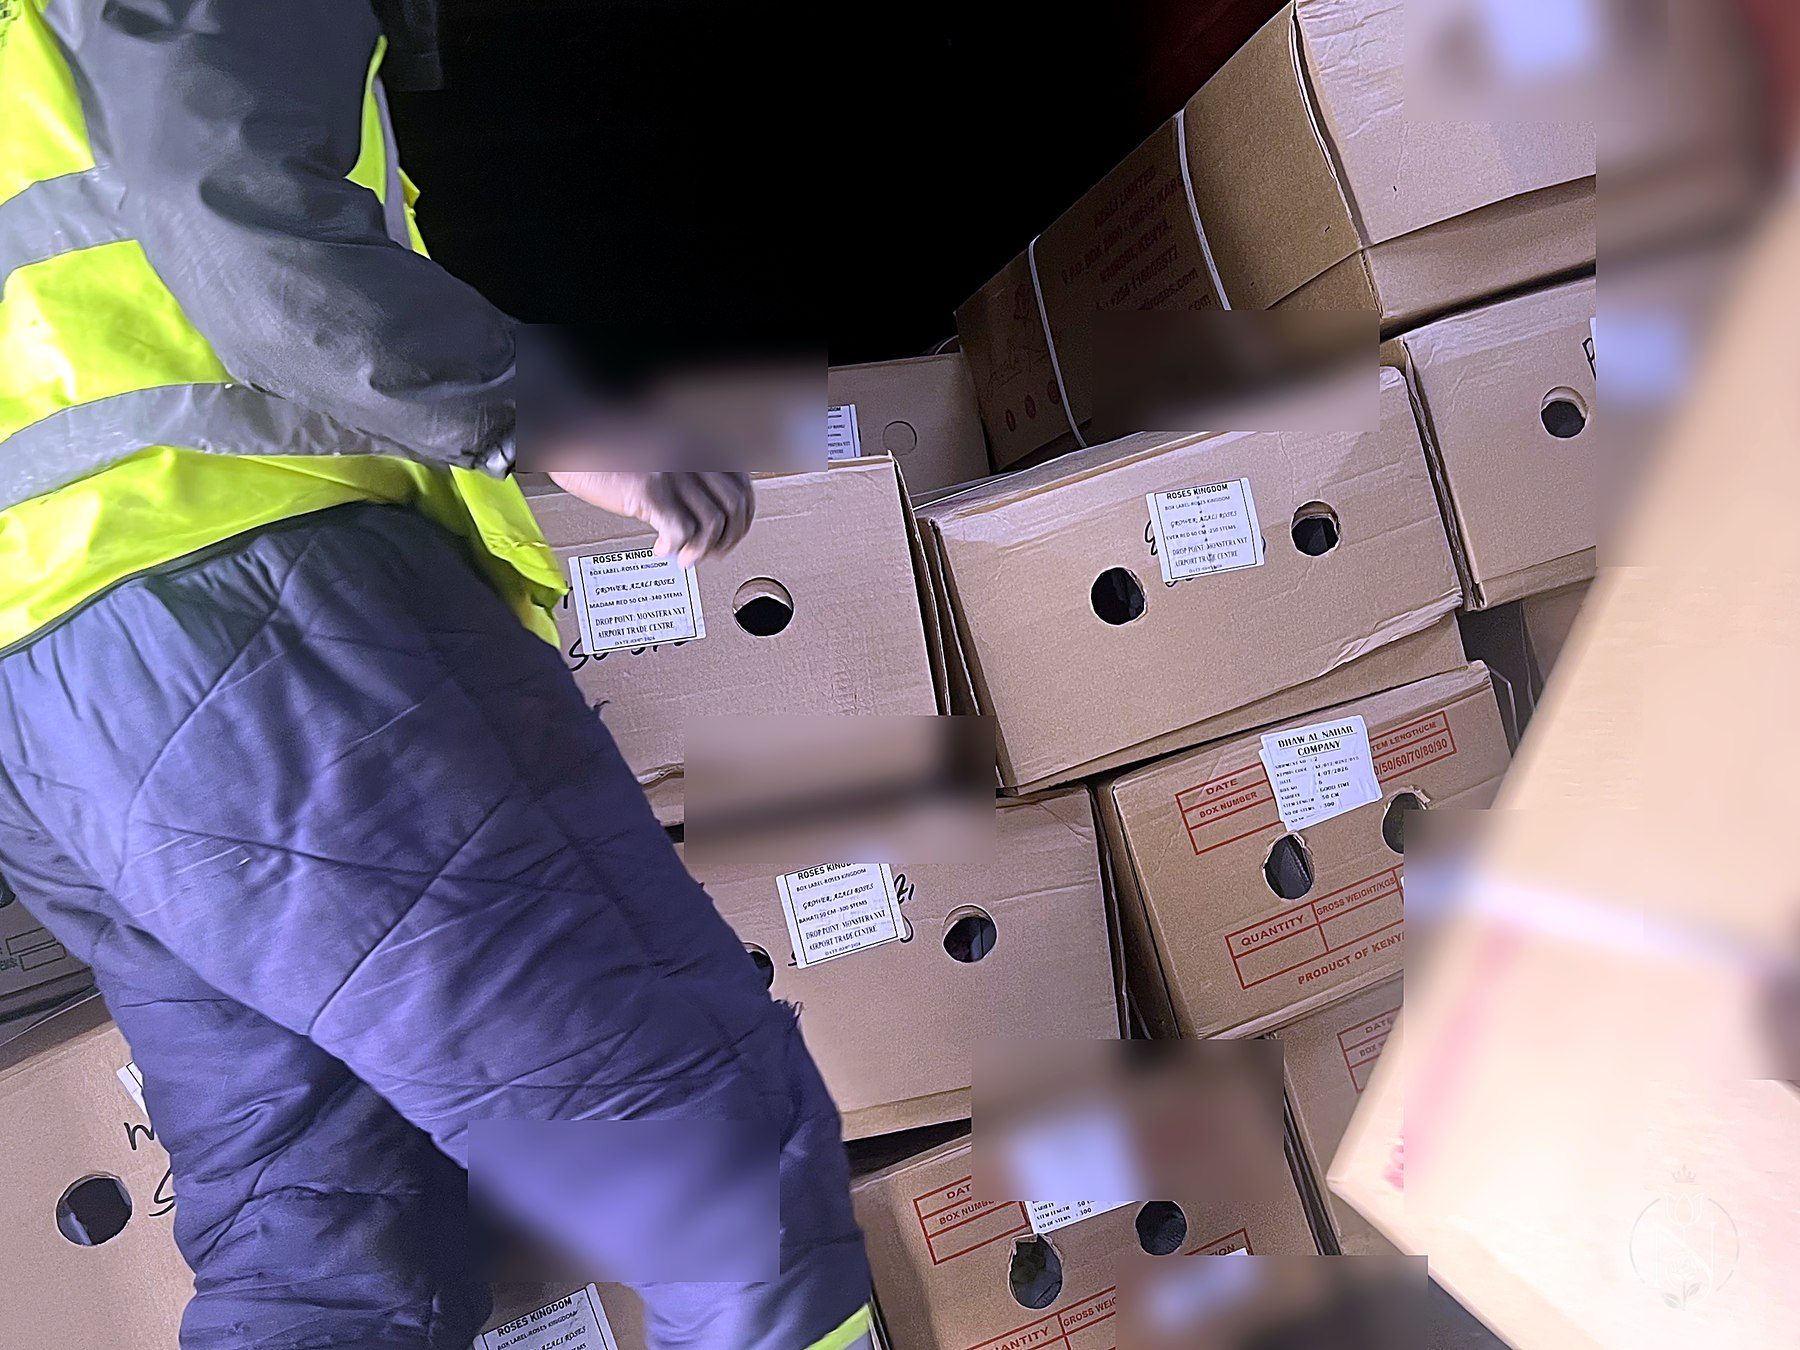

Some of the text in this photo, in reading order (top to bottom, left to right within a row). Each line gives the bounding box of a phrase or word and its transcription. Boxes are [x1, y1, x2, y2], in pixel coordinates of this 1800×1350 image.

[1166, 484, 1228, 499] ROSES KINGDOM
[592, 548, 653, 564] ROSES KINGD
[1217, 550, 1238, 559] CENTRE
[589, 601, 614, 609] MADAM
[595, 617, 613, 626] DROP
[636, 610, 672, 620] MONSTERA
[598, 621, 674, 638] AIRPORT TRADE CENTRE
[1278, 726, 1353, 748] DHAW AL NAHAR
[1297, 740, 1339, 756] COMPANY
[1205, 778, 1239, 796] DATE
[1199, 791, 1259, 818] BOX NUMBER
[797, 866, 825, 880] ROSES
[841, 868, 866, 878] KINGDOM
[854, 883, 874, 893] ROSES
[850, 900, 867, 908] STEMS
[1241, 877, 1396, 947] QUANTITY GROSS WEIGHT/KGS
[806, 929, 821, 939] DROP
[842, 914, 873, 927] MONSTERA
[809, 925, 876, 950] AIRPORT TRADE CENTRE
[1298, 955, 1351, 985] PRODUCT
[1354, 947, 1369, 961] OF
[1359, 1042, 1377, 1057] BOX
[946, 1183, 971, 1199] DAT
[939, 1211, 960, 1225] BOX
[497, 1297, 572, 1337] ROSES KINGDOM
[1063, 1308, 1094, 1326] GROSS
[565, 1325, 586, 1342] ROSES
[996, 1326, 1049, 1350] ANTITY
